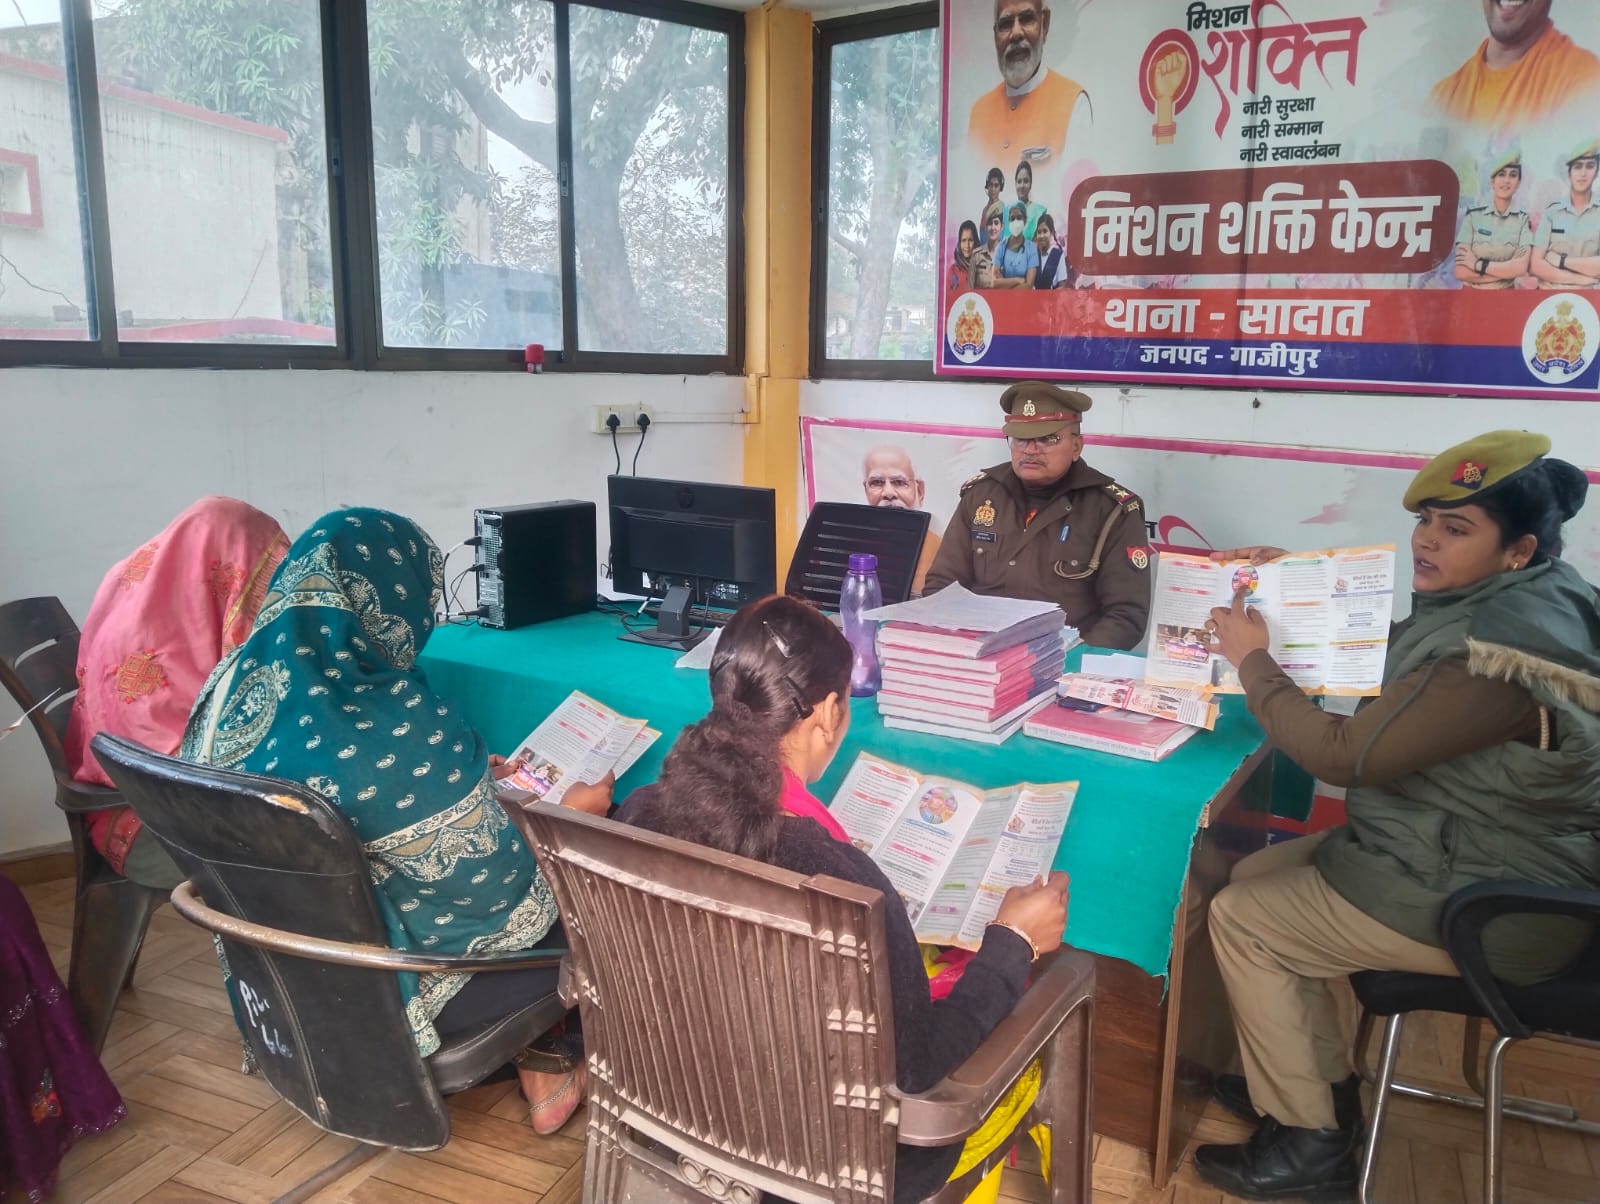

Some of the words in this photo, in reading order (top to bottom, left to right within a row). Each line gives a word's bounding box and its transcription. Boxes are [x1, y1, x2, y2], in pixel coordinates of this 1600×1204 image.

[1186, 1, 1251, 31] मिशन
[1200, 0, 1368, 141] शक्ति
[1242, 95, 1273, 116] नारी
[1276, 97, 1316, 121] सुरक्षा
[1241, 119, 1271, 140] नारी
[1274, 121, 1324, 138] सम्मान
[1239, 142, 1269, 163] नारी
[1271, 139, 1342, 161] स्वावलंबन
[1081, 190, 1210, 257] मिशन
[1218, 181, 1323, 255] शक्ति
[1329, 179, 1441, 258] केन्द्र
[1104, 298, 1201, 333] थाना
[1209, 312, 1226, 321] -
[1236, 299, 1371, 337] सादात
[1140, 344, 1210, 365] जनपद
[1230, 342, 1321, 376] गाजीपुर
